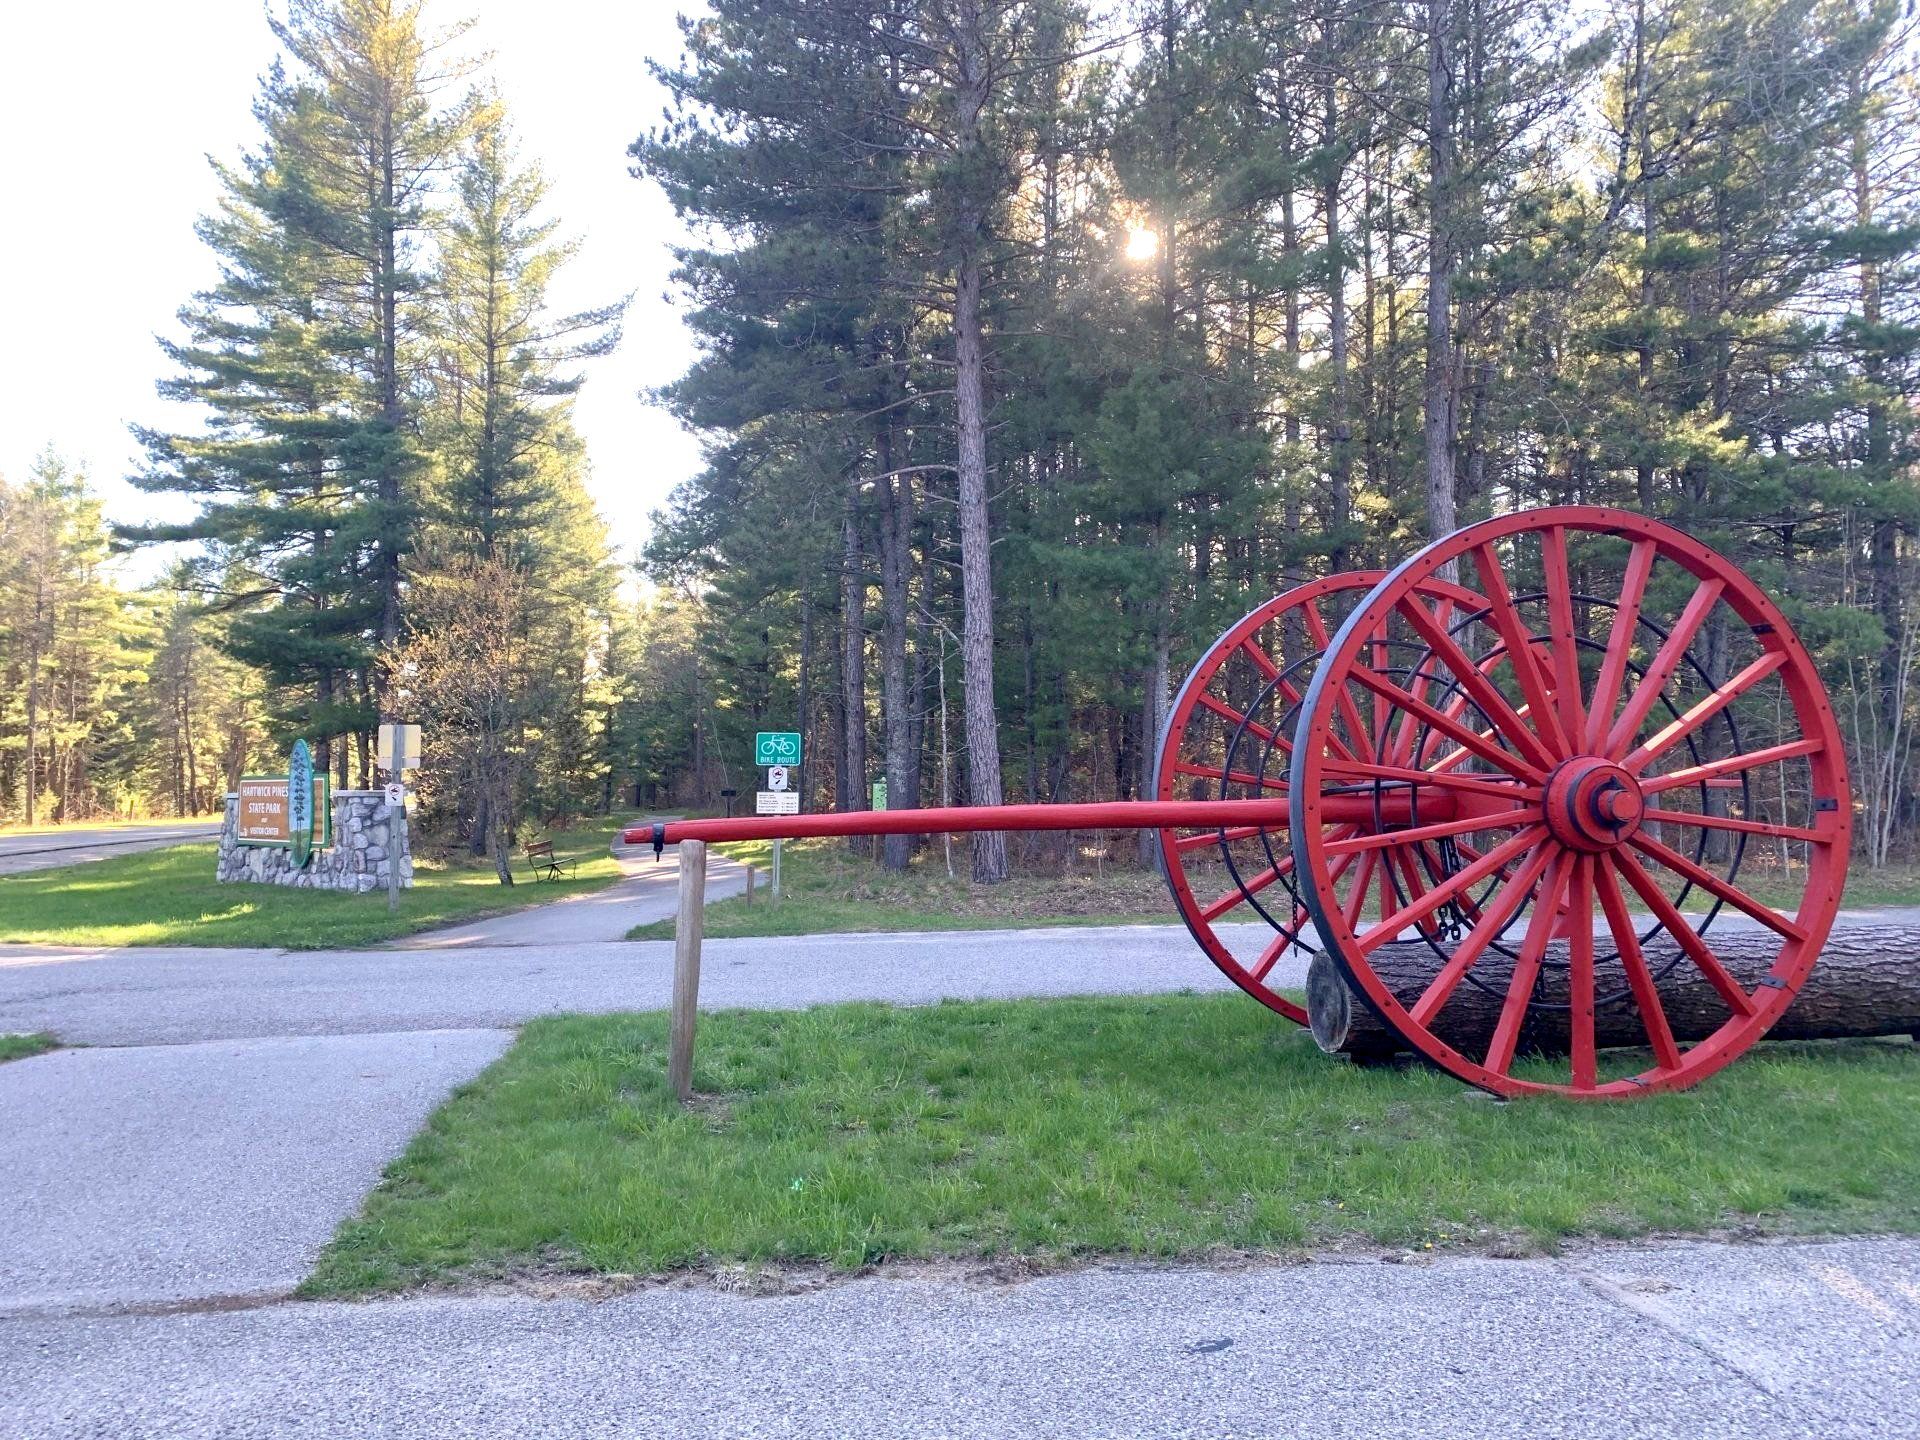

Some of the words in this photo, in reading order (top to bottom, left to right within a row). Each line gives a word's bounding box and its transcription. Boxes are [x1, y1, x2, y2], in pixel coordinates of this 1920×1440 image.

[242, 786, 270, 797] HARTWICK
[272, 786, 289, 797] PINES
[248, 803, 265, 814] STATE
[265, 803, 281, 814] PARK
